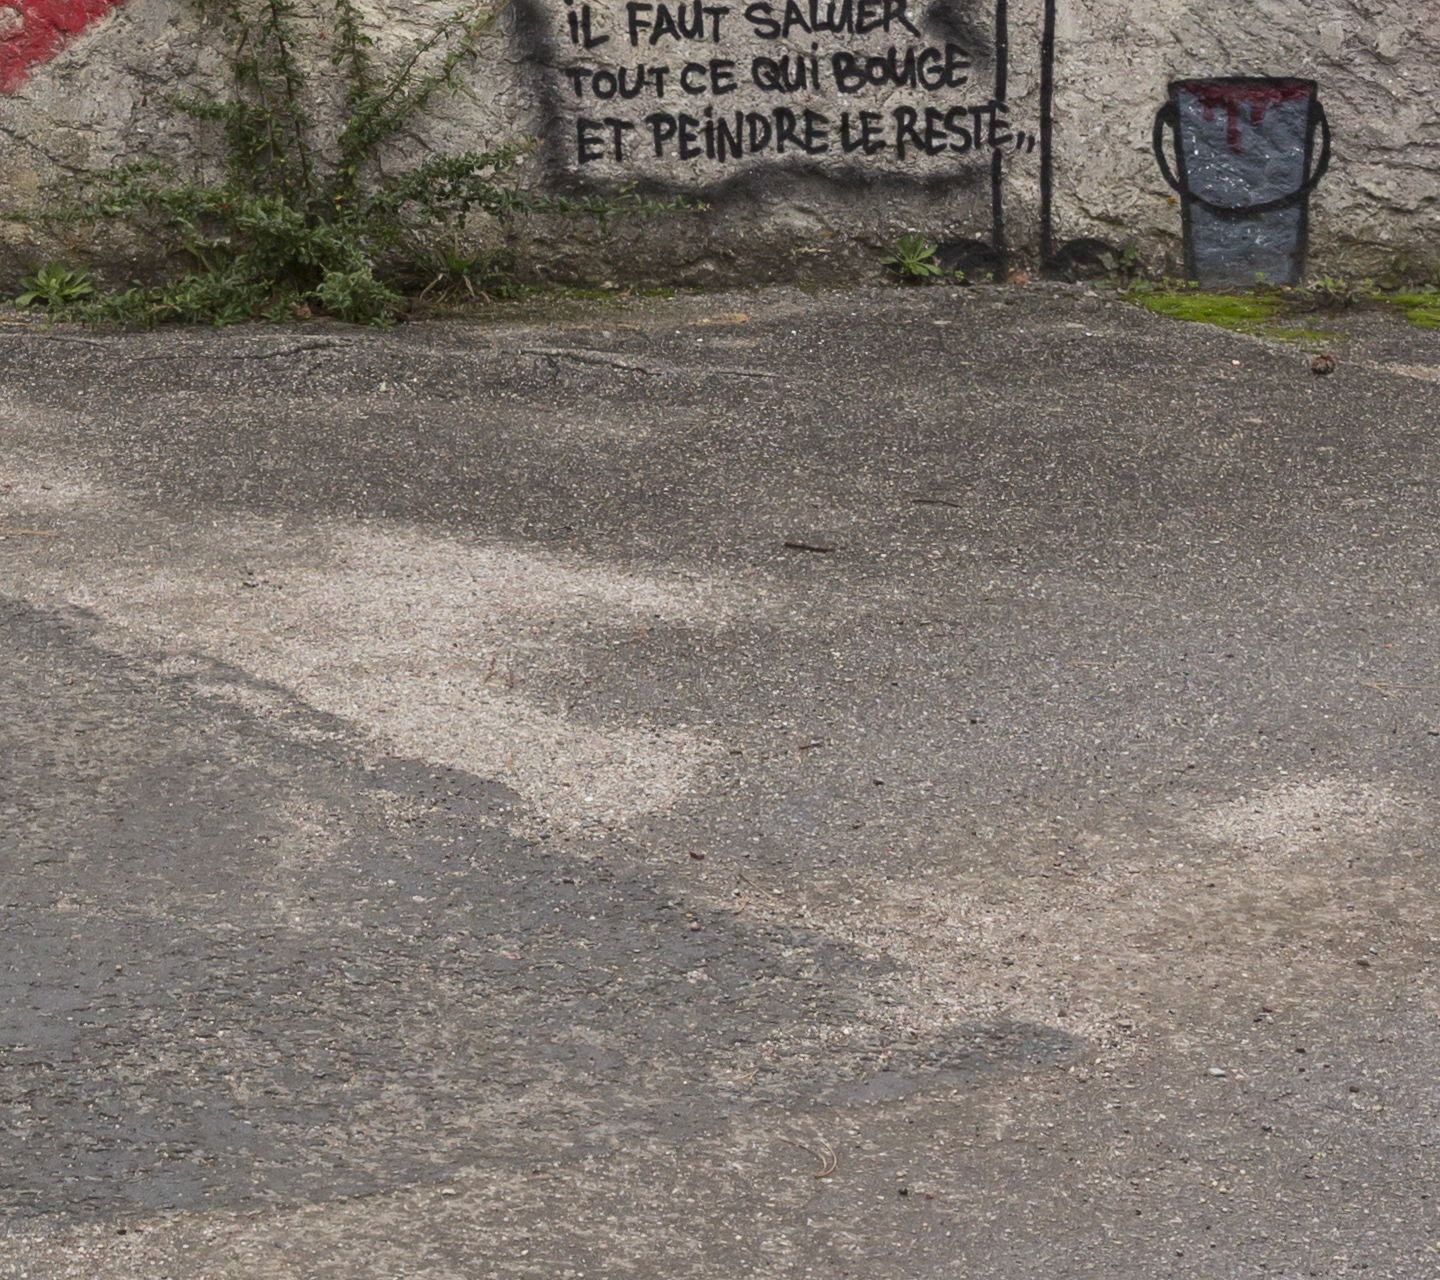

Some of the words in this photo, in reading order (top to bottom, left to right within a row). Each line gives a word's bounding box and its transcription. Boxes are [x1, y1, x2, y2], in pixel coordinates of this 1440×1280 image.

[566, 64, 670, 100] TOUT
[680, 58, 738, 95] CE
[832, 42, 975, 94] BOUGE
[576, 115, 635, 164] ET
[840, 109, 885, 155] LE
